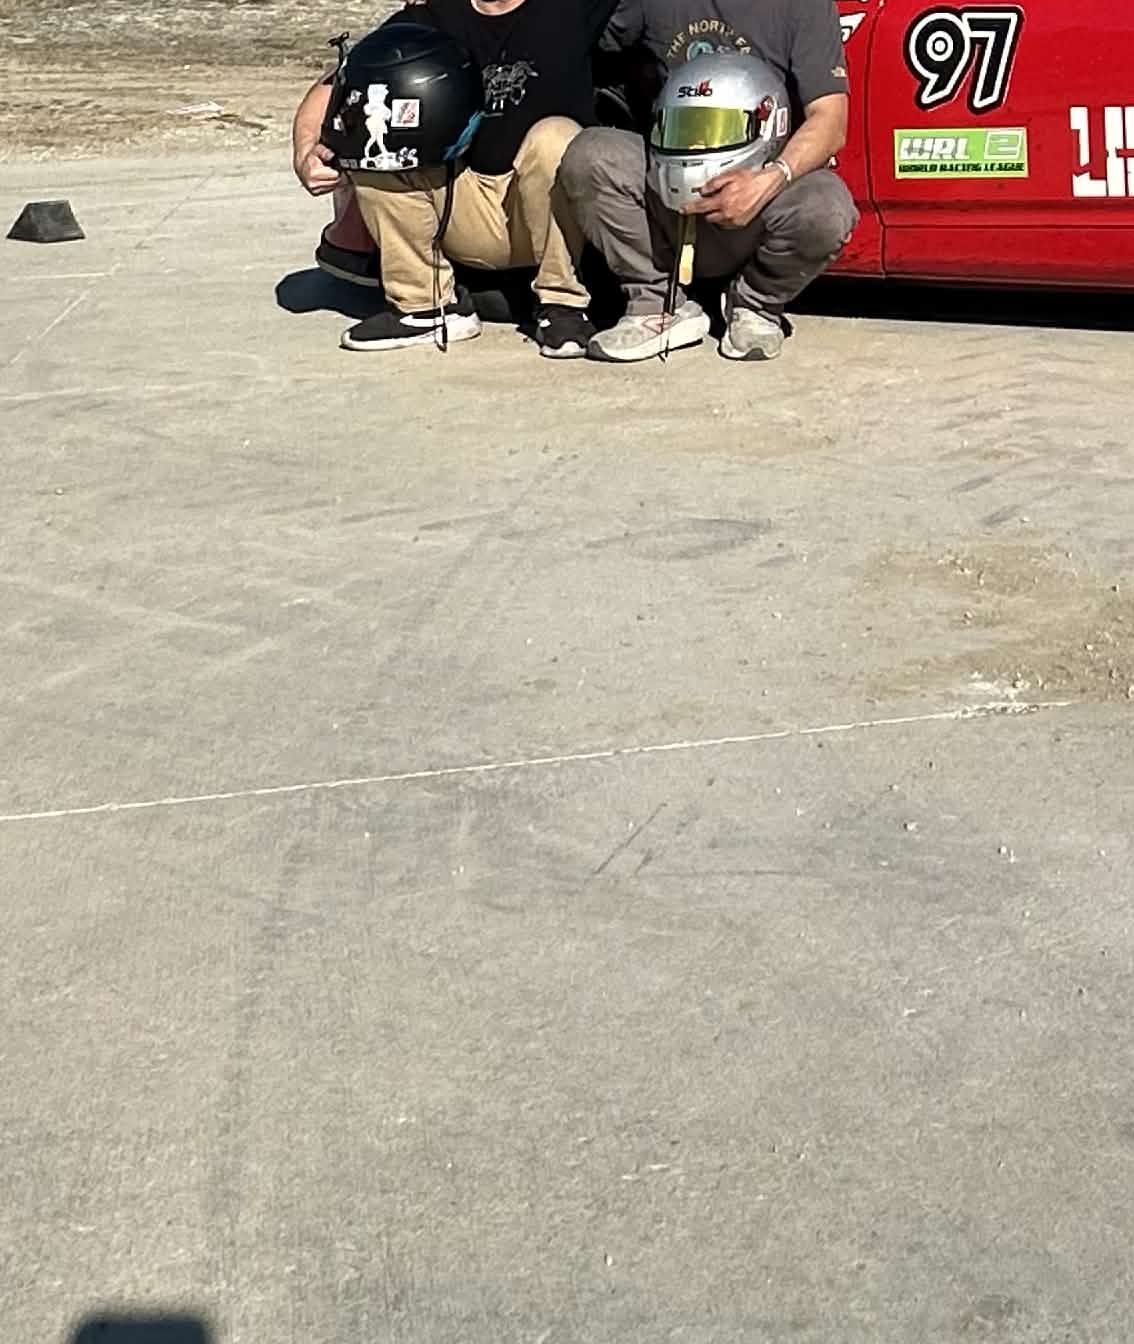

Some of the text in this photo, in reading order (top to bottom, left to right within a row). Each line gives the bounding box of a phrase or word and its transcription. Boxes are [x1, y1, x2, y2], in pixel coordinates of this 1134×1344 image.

[666, 31, 688, 59] THE
[688, 18, 735, 38] NORTH
[904, 6, 1022, 115] 97
[899, 136, 971, 161] WRL
[898, 162, 1025, 173] WORLD RACING LEAGUE
